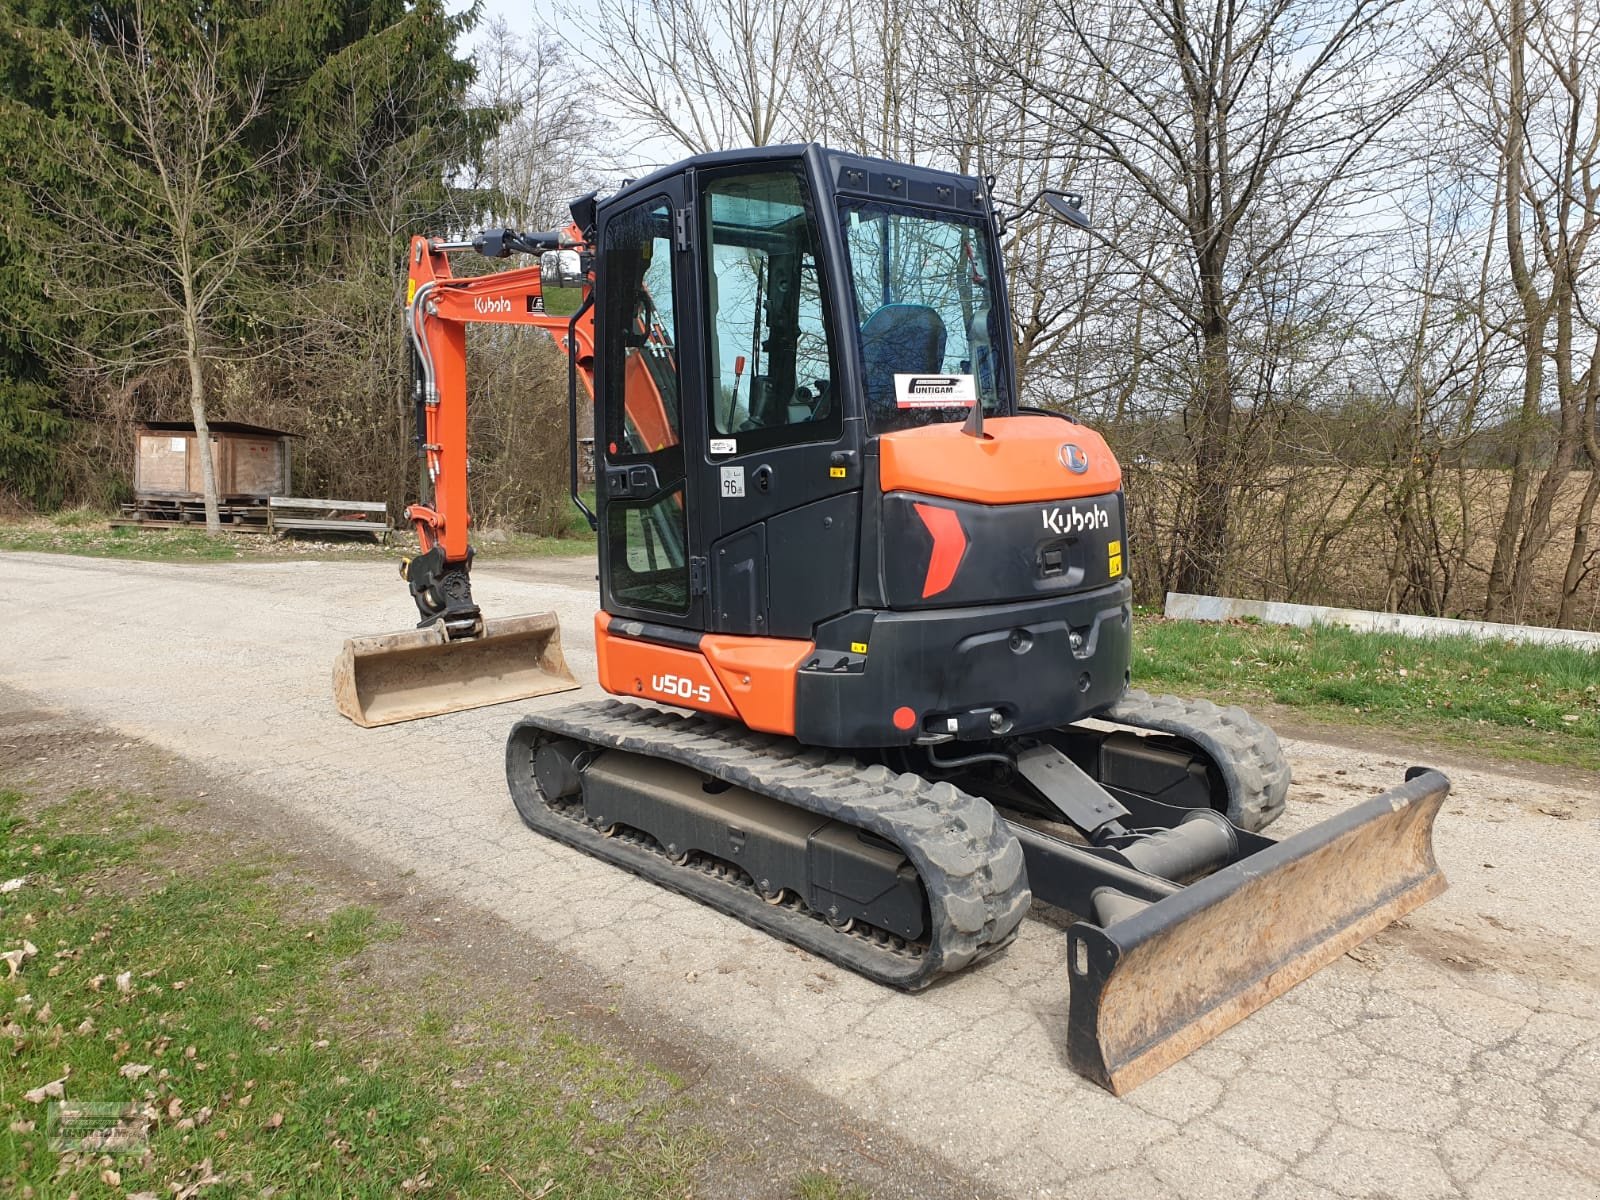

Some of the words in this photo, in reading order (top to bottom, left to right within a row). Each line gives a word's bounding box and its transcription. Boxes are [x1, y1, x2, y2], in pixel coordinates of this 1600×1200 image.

[474, 296, 511, 314] Kubota
[723, 480, 737, 495] 96
[1042, 504, 1109, 534] Kubota
